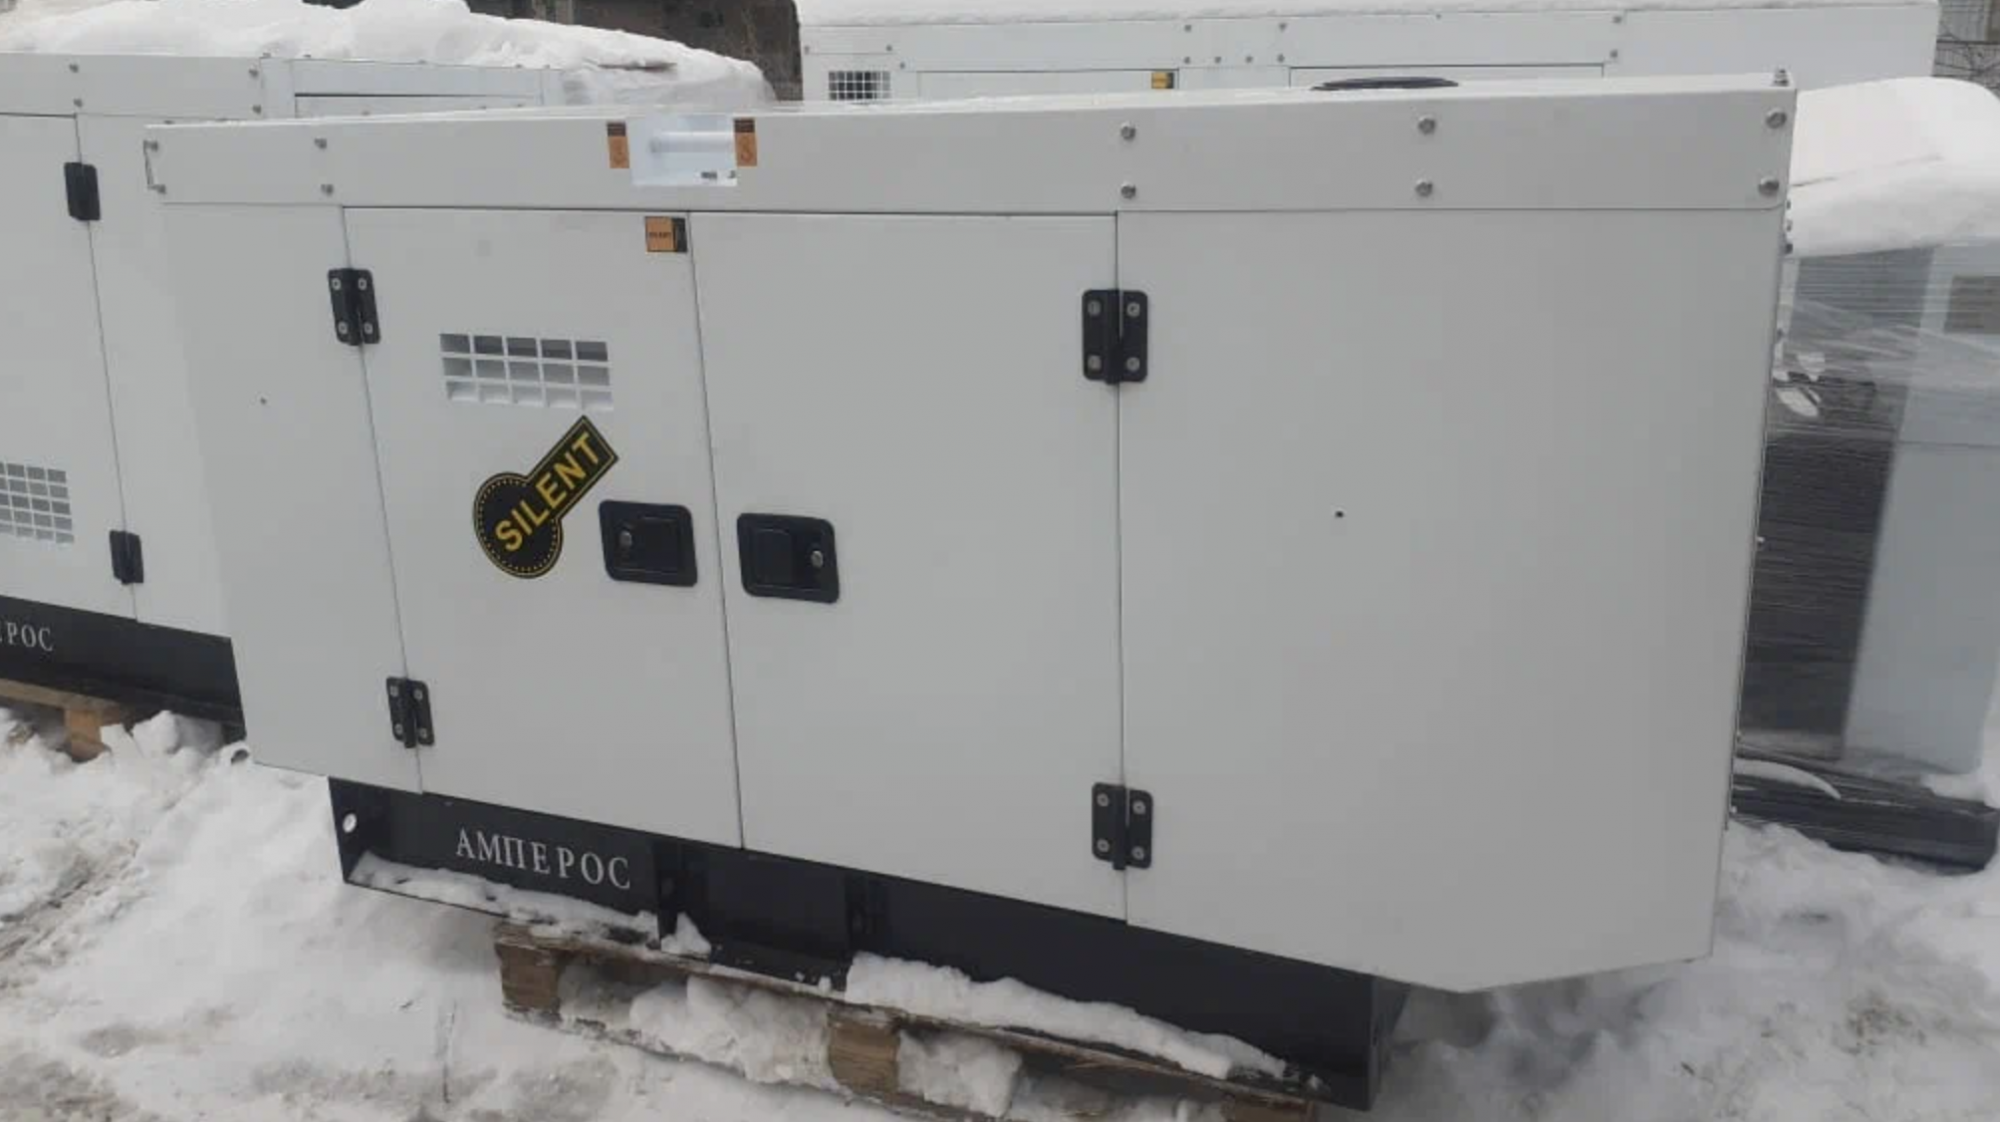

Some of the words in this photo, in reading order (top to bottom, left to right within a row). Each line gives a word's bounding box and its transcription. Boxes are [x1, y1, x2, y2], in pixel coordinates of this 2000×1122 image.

[495, 432, 599, 551] SILENT
[0, 622, 53, 652] РОС
[456, 827, 630, 889] АМПЕРОС
